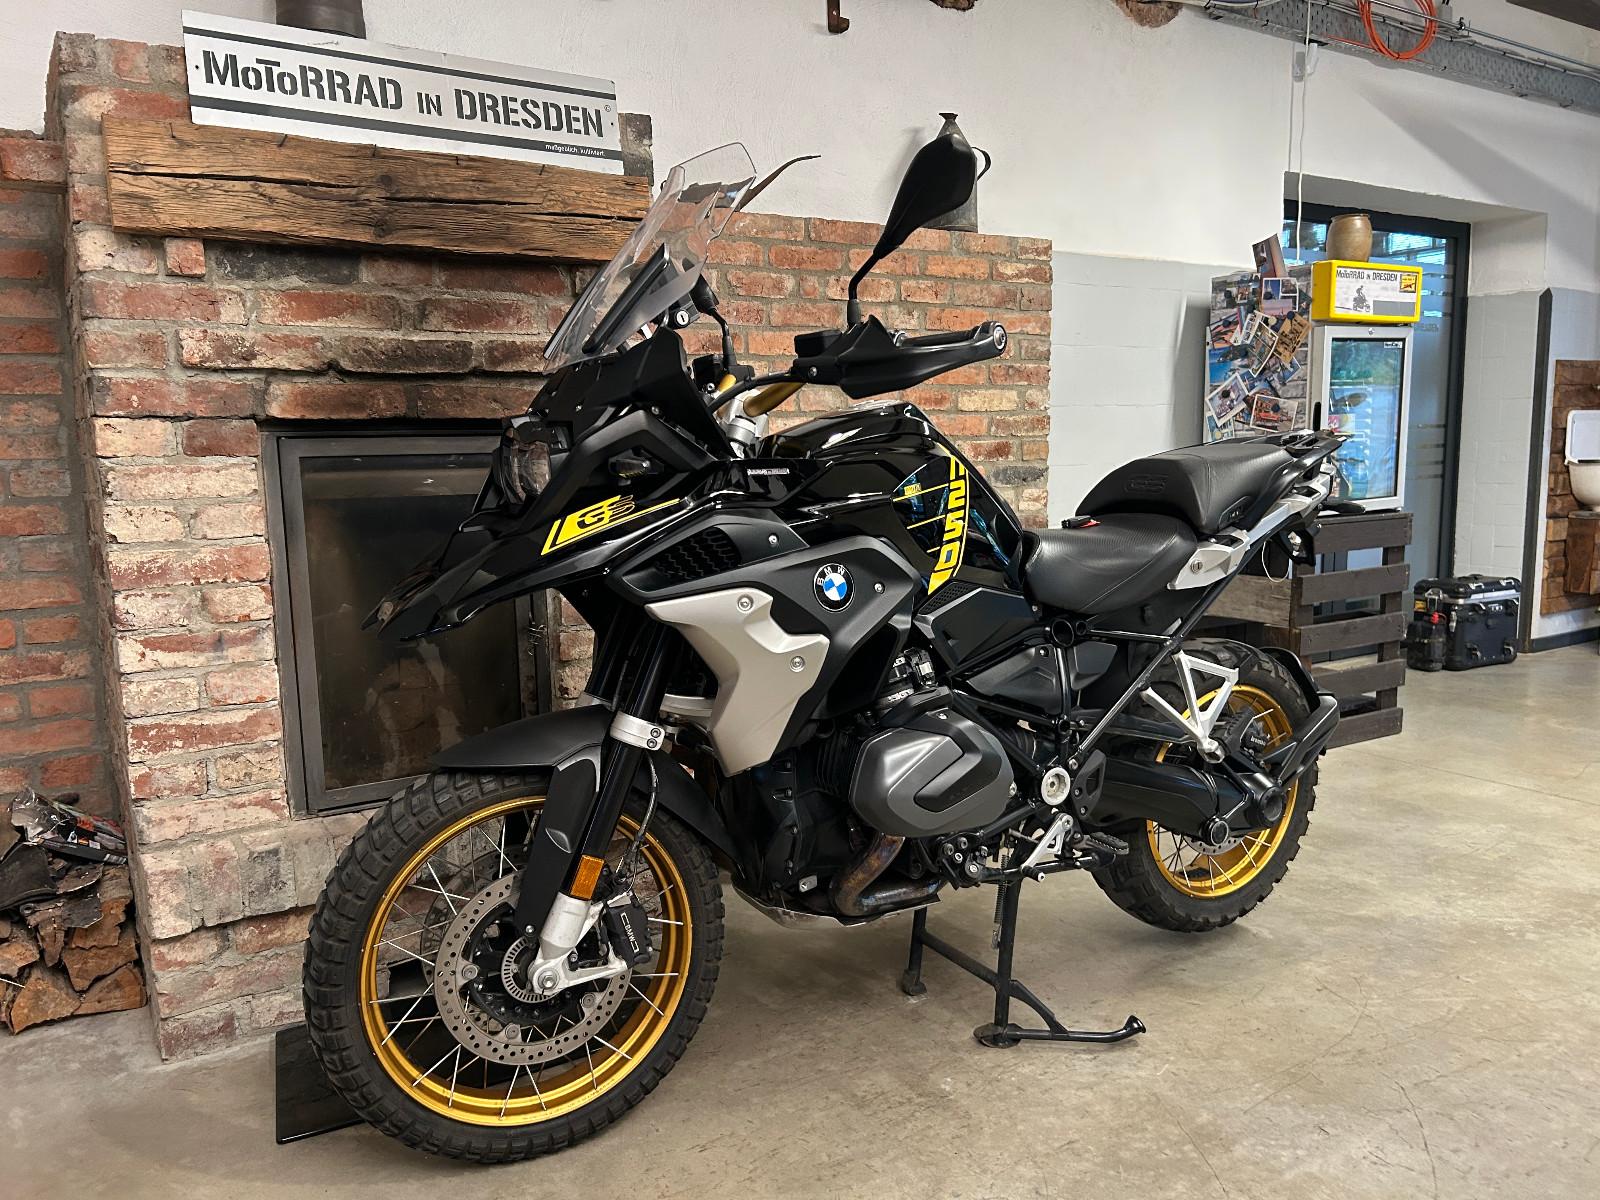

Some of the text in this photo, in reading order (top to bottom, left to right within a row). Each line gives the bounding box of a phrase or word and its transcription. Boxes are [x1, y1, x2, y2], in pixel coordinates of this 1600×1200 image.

[416, 91, 443, 117] IN
[454, 88, 604, 138] DRESDEN
[816, 565, 846, 587] BMW
[624, 924, 636, 942] BMW
